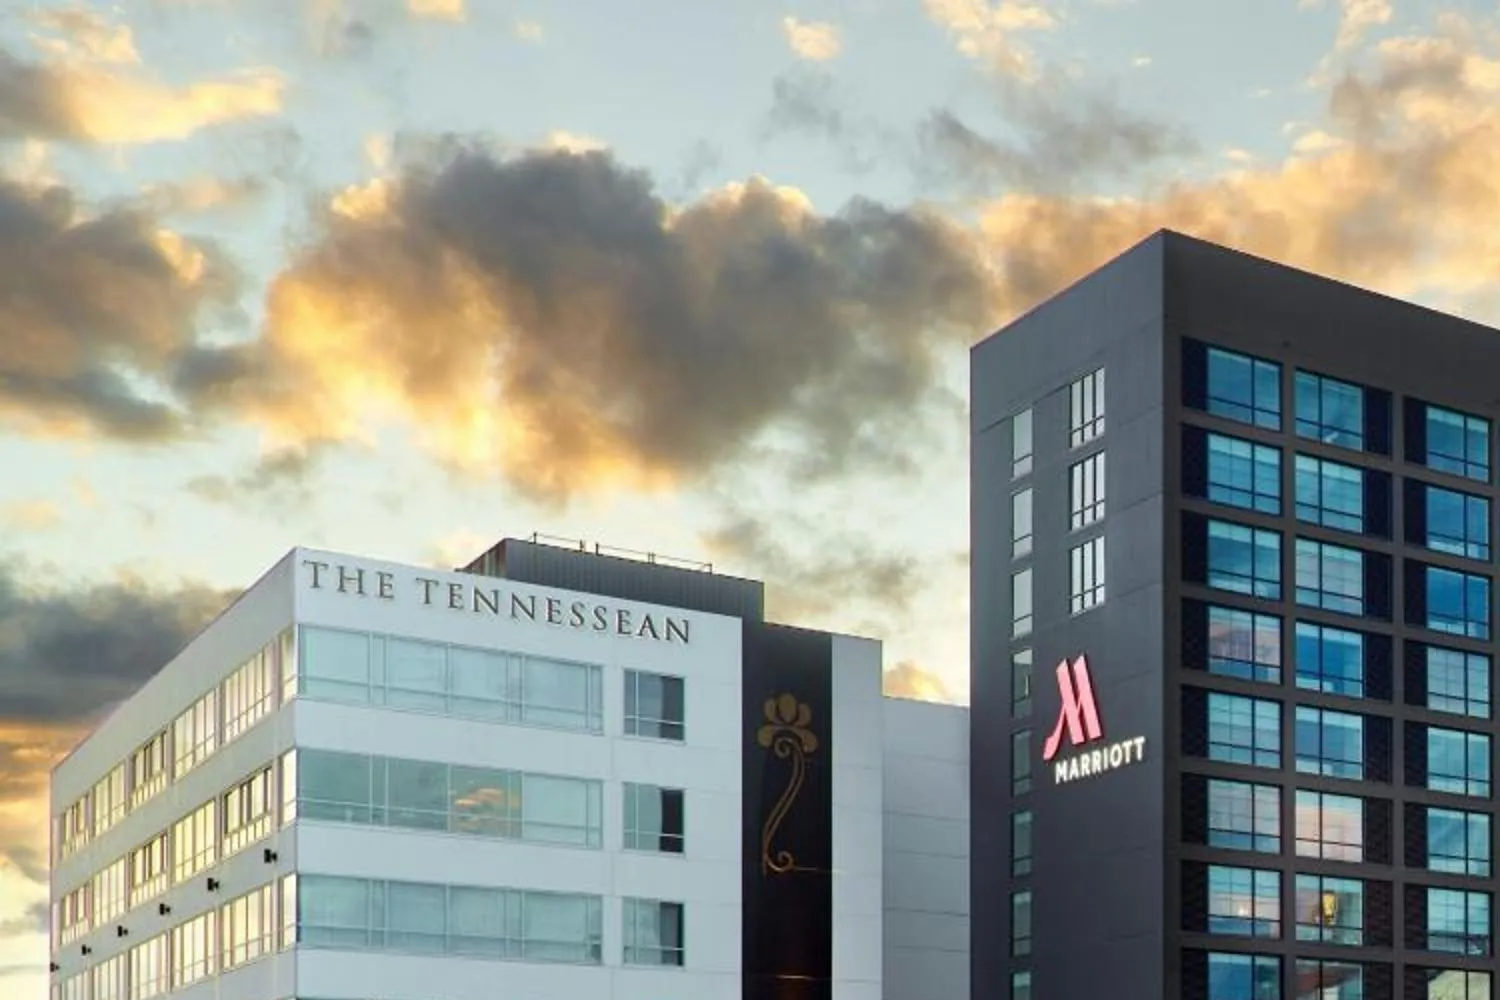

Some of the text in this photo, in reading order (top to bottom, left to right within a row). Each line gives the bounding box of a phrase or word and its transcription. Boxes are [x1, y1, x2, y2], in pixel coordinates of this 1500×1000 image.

[303, 560, 690, 644] THE TENNESSEAN
[1055, 735, 1145, 785] MARRIOTT
